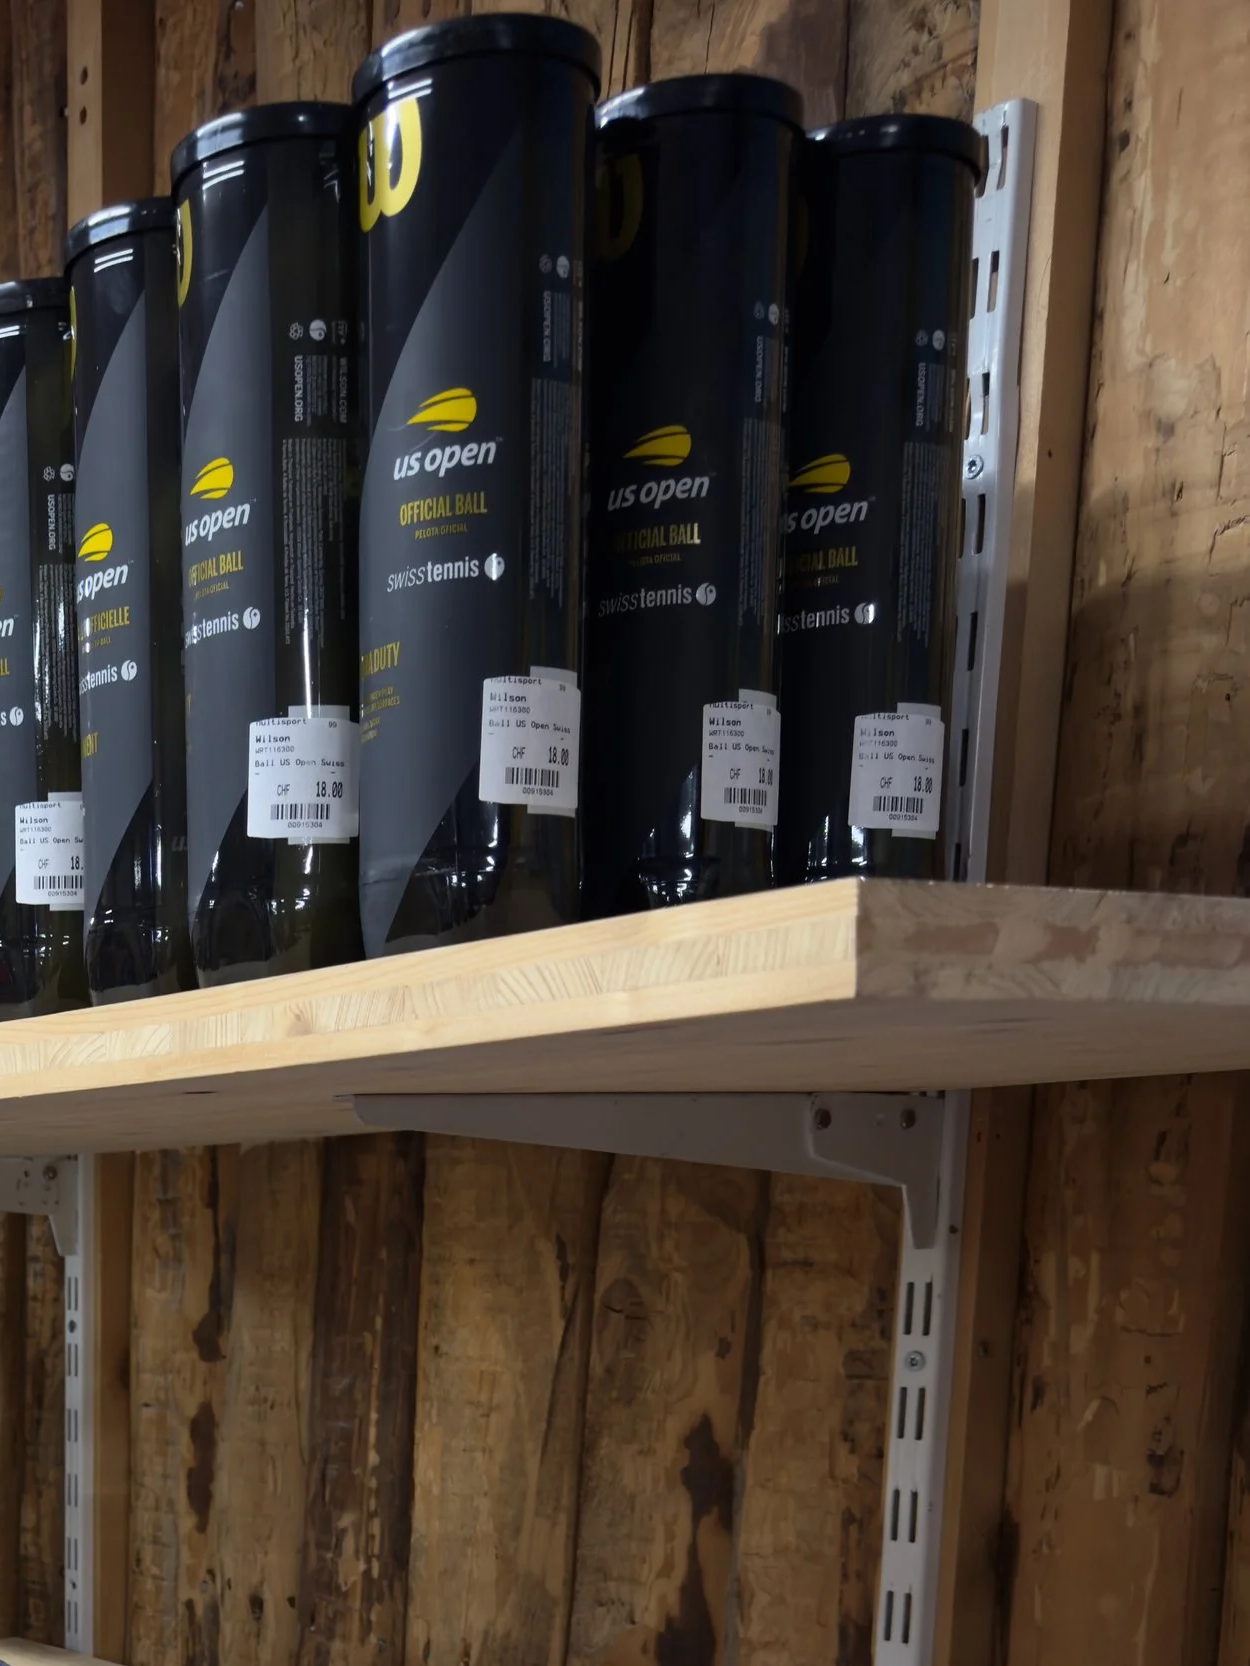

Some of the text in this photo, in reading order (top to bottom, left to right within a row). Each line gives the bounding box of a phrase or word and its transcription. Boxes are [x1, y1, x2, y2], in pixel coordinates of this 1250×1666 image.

[294, 354, 304, 422] USOPEN.ORG
[393, 440, 497, 480] us open
[400, 491, 488, 526] OFFICIAL BALL
[607, 474, 710, 512] us open
[47, 494, 56, 550] USOPEN.ORG
[185, 502, 251, 547] us open
[670, 522, 701, 546] BALL
[800, 500, 869, 535] open
[189, 550, 244, 586] OFFICIAL BALL
[386, 556, 480, 593] swisstennis
[828, 546, 858, 569] BALL
[84, 564, 129, 600] open
[598, 584, 692, 618] swisstennis
[374, 642, 400, 673] DUTY
[254, 760, 274, 768] Ball
[296, 759, 316, 767] Open
[277, 781, 343, 798] CHF 18.00
[70, 856, 84, 870] 18.
